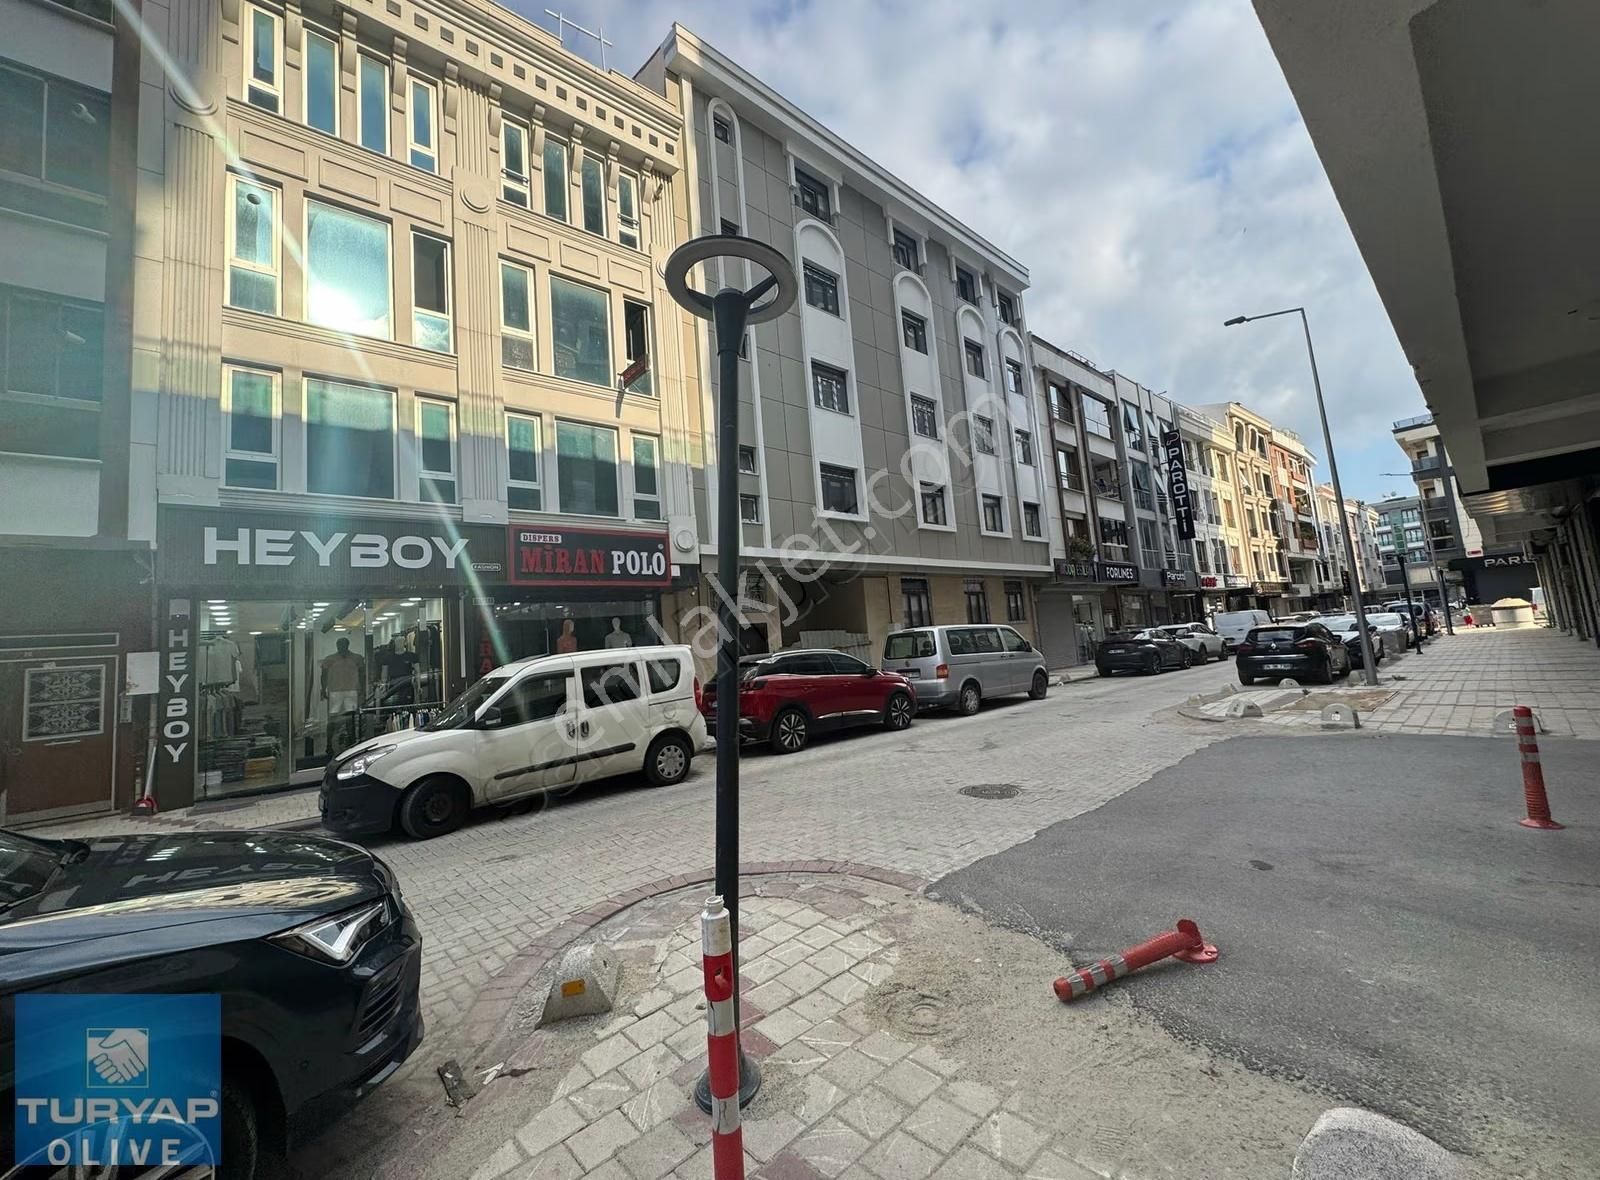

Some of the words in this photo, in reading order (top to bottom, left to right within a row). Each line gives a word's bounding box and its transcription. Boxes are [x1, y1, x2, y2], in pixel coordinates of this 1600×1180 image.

[203, 526, 470, 569] HEYBOY
[522, 533, 560, 543] DISPERS
[611, 549, 666, 576] POLO
[1106, 567, 1134, 579] FORLINES
[163, 629, 190, 762] HEYBOY
